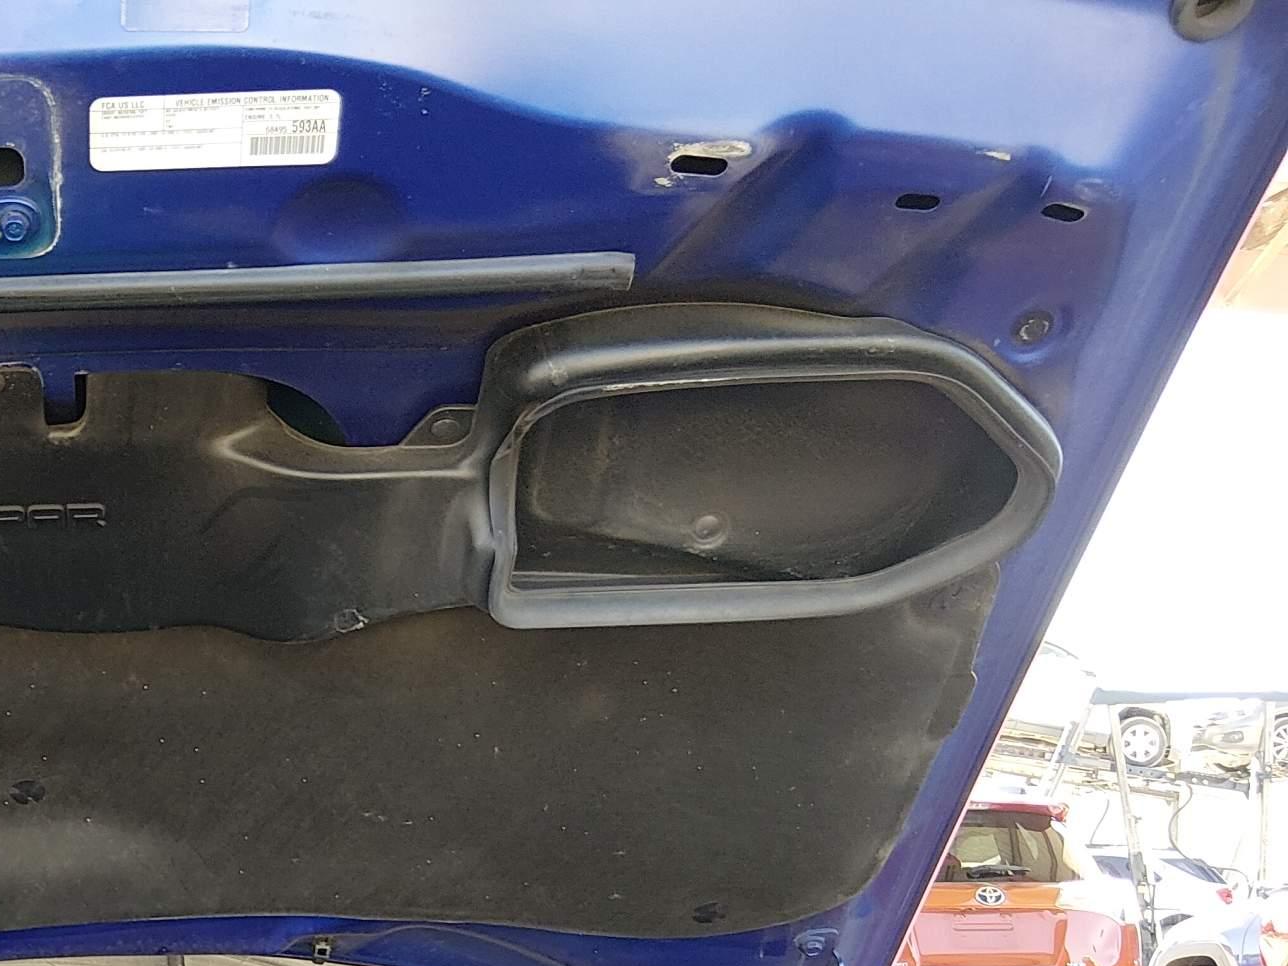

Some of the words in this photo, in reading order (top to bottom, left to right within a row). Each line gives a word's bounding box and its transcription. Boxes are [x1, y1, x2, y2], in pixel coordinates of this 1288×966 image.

[101, 102, 115, 110] FCA
[118, 101, 129, 109] US
[175, 98, 205, 107] VEHICLE
[207, 96, 241, 106] EMISSION
[243, 95, 276, 105] CONTROL
[280, 94, 329, 104] INFORMATION
[292, 119, 326, 133] 593AA
